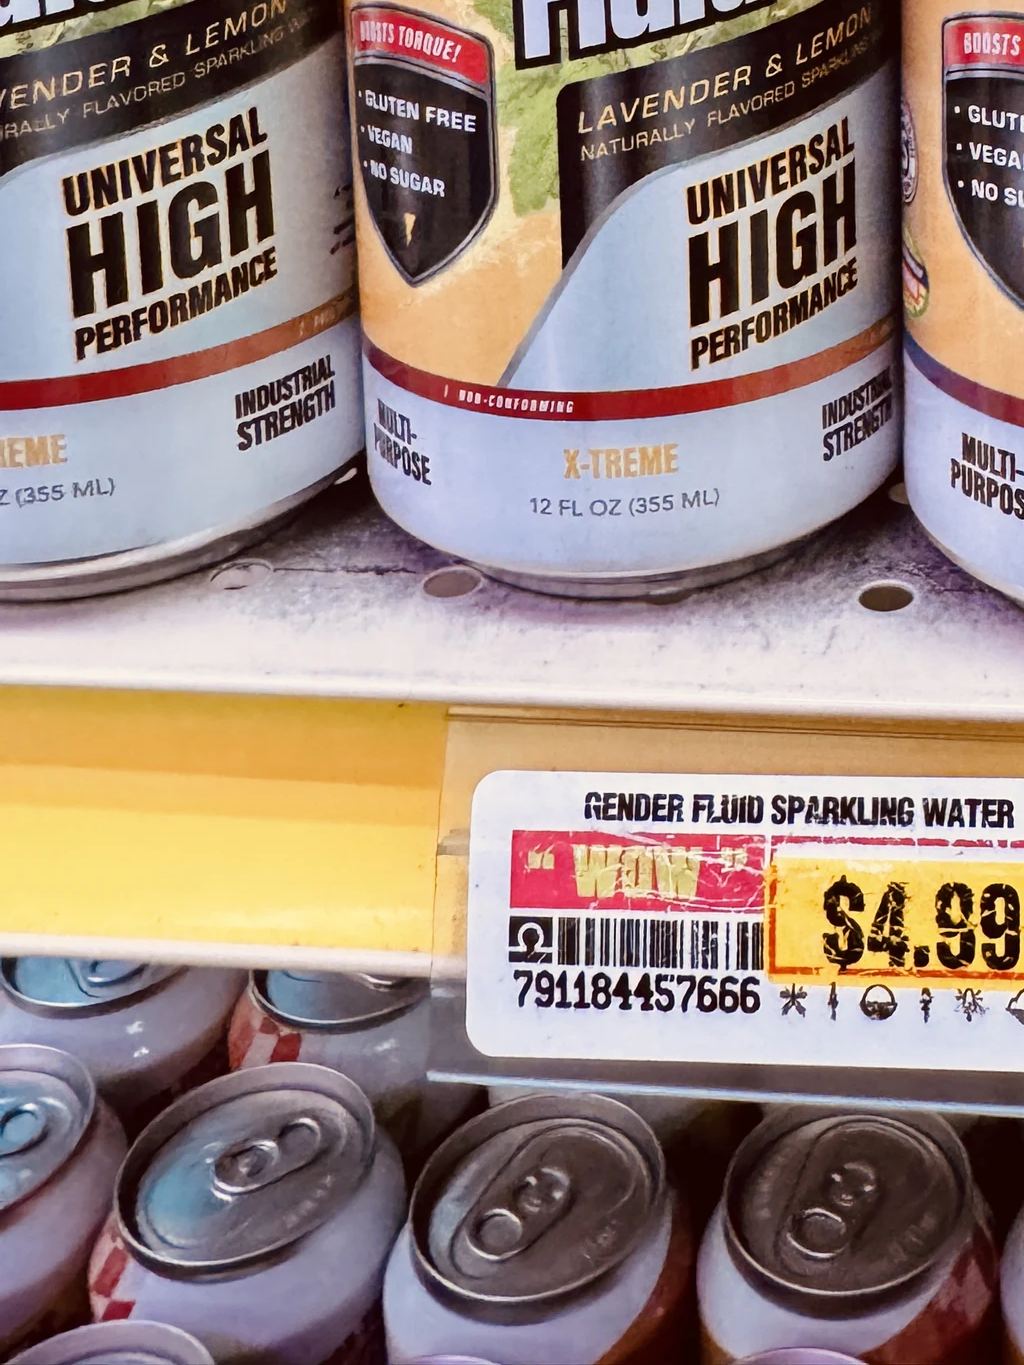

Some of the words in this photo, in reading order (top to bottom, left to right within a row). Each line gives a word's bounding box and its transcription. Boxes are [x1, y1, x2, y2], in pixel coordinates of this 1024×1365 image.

[398, 25, 462, 63] TORQUE!
[577, 64, 752, 135] LAVENDER
[765, 53, 783, 78] &
[796, 2, 872, 65] LEMON
[963, 32, 1021, 56] BOOSTS
[0, 55, 131, 109] ENDER
[149, 44, 169, 68] &
[0, 108, 70, 139] RALLY
[83, 71, 186, 118] FLAVORED
[365, 89, 419, 121] GLUTEN
[425, 106, 477, 133] FREE
[368, 124, 412, 155] VEGAN
[580, 117, 696, 162] NATURALLY
[707, 80, 795, 128] FLAVORED
[61, 106, 268, 216] UNIVERSAL
[370, 160, 387, 181] NO
[390, 166, 445, 197] SUGAR
[686, 116, 855, 225] UNIVERSAL
[971, 178, 998, 202] NO
[65, 149, 275, 319] HIGH
[688, 157, 857, 329] HIGH
[74, 246, 278, 363] PERFORMANCE
[690, 256, 858, 371] PERFORMANCE
[234, 354, 336, 419] INDUSTRIAL
[236, 380, 336, 452] STRENGTH
[377, 398, 417, 445] MULTI-
[374, 423, 432, 486] PURPOSE
[563, 443, 680, 480] X-TREME
[15, 485, 65, 508] (355
[72, 477, 115, 499] ML)
[530, 497, 553, 516] 12
[559, 500, 583, 517] FL
[589, 499, 622, 517] OZ
[629, 494, 674, 517] (355
[681, 487, 720, 510] ML)
[584, 791, 685, 822] GENDER
[691, 793, 764, 824] FLUID
[771, 795, 914, 827] SPARKLING
[922, 798, 1015, 828] WATER
[822, 875, 1021, 972] $4.99
[513, 969, 761, 1014] 791184457666
